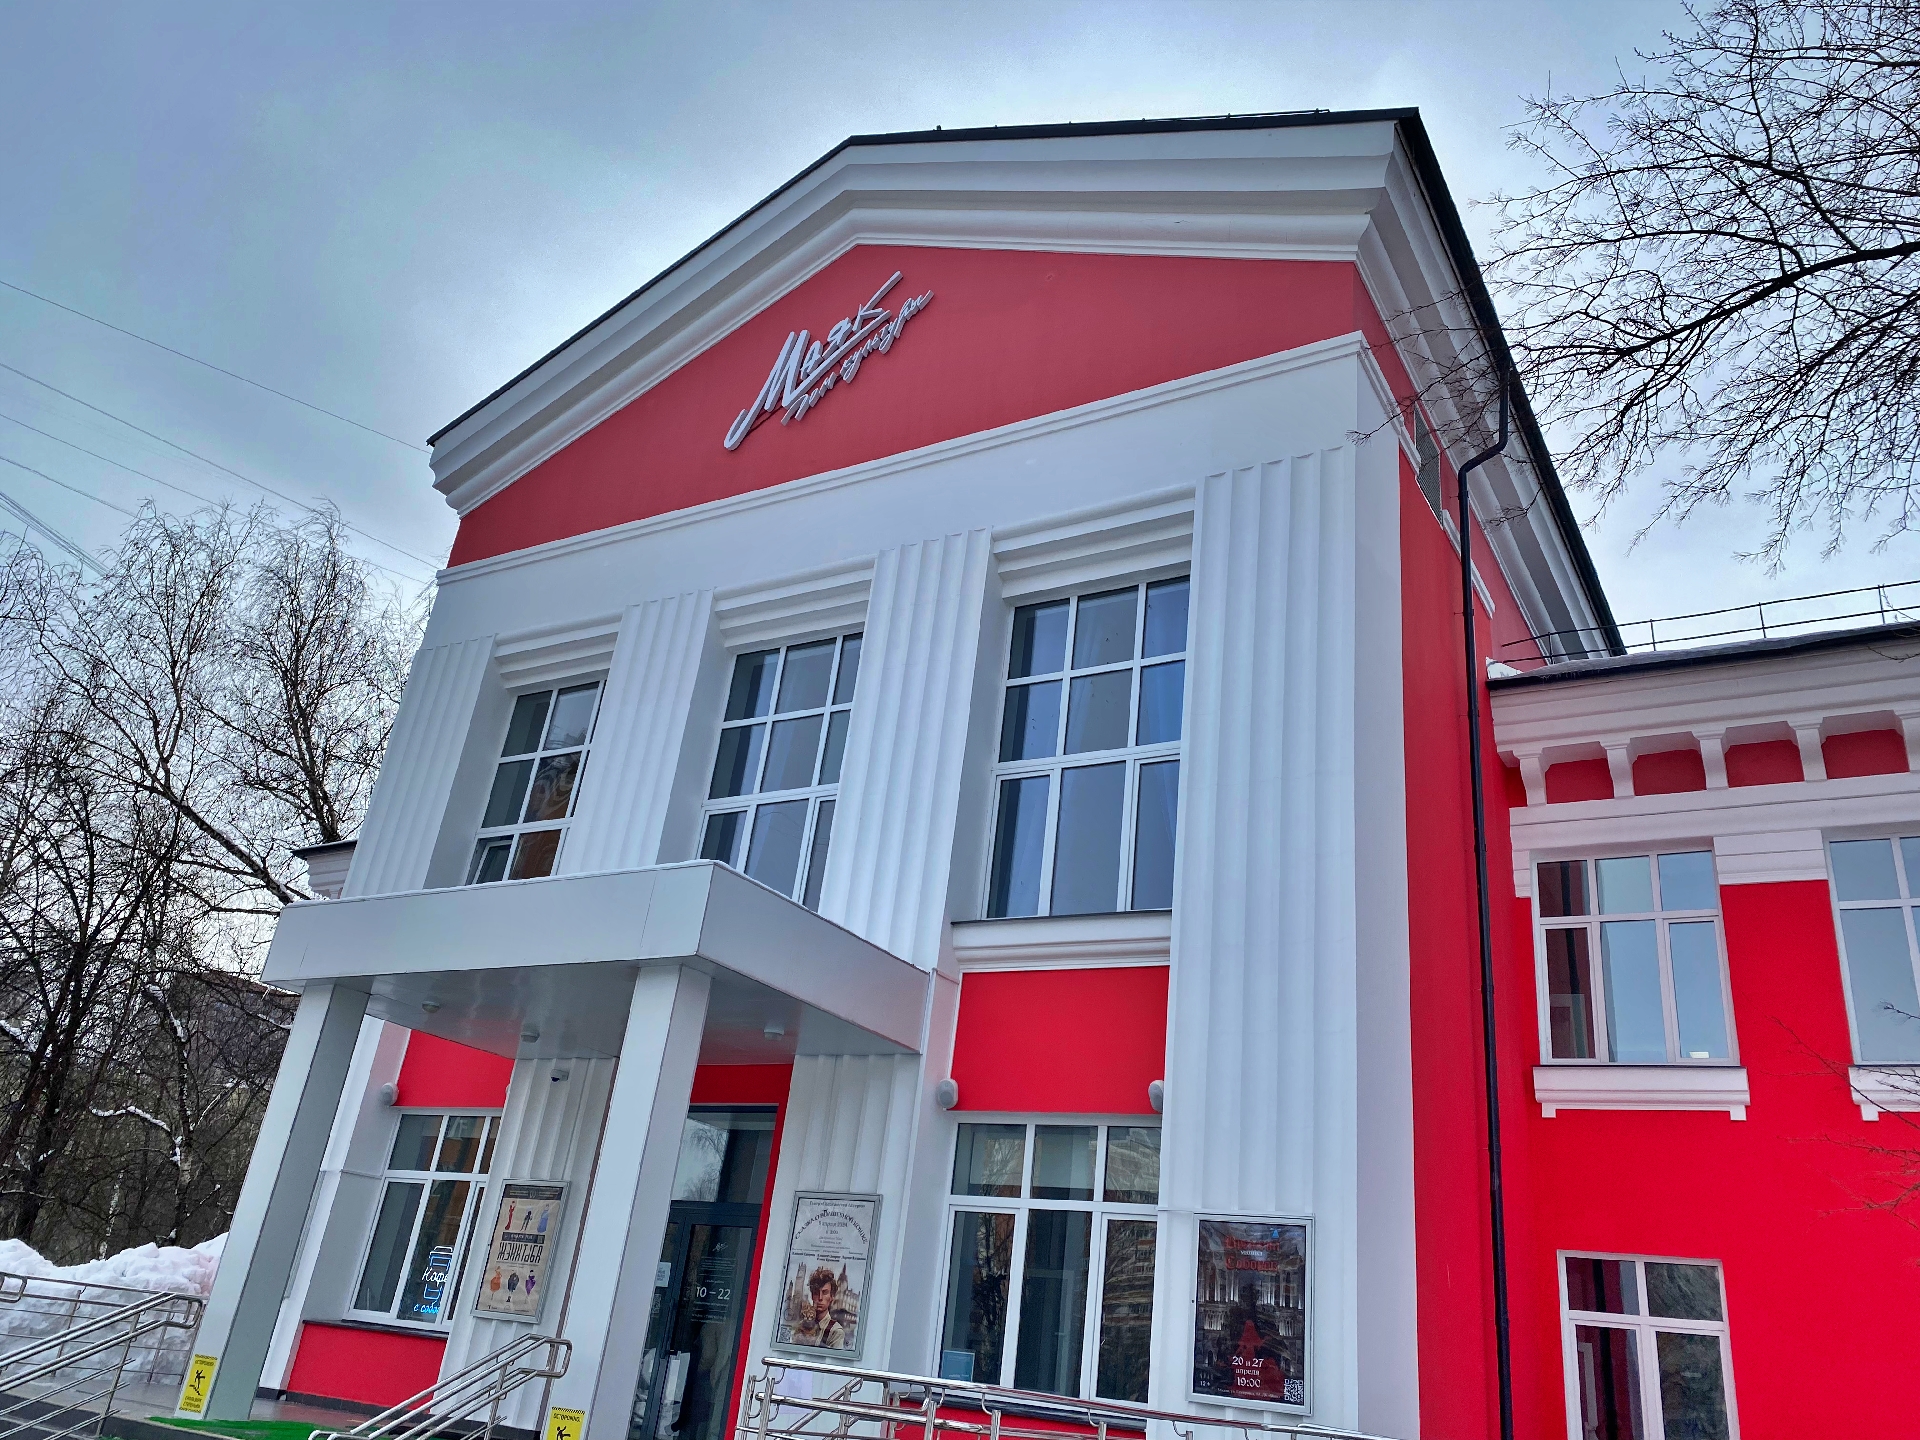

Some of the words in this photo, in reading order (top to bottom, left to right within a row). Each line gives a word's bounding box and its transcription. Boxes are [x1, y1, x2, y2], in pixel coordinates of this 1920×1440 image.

[696, 1286, 707, 1298] 10
[717, 1288, 731, 1300] 22
[1232, 1356, 1244, 1366] 20
[1251, 1358, 1264, 1368] 27
[1235, 1367, 1260, 1376] апреля
[1236, 1376, 1261, 1388] 19:00
